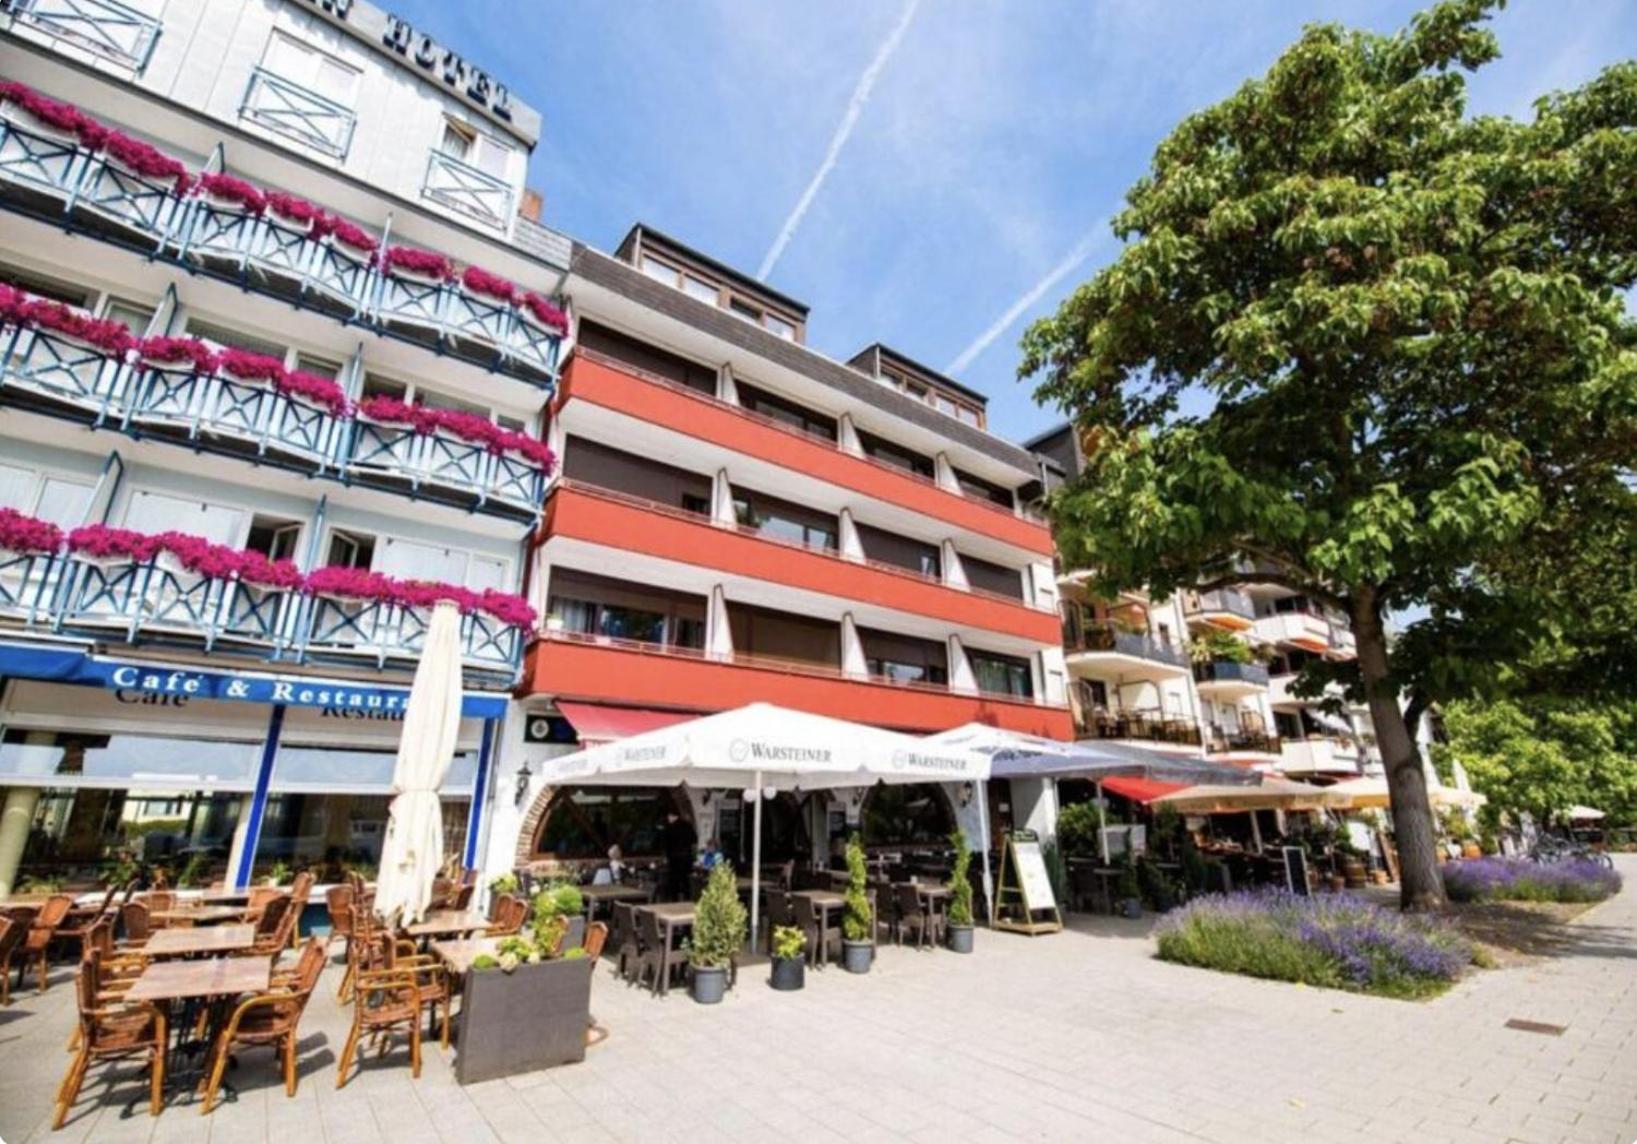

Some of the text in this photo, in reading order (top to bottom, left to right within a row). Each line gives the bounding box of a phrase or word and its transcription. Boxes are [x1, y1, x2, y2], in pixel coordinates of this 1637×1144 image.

[382, 14, 513, 122] HOTEL
[113, 666, 204, 693] Café
[226, 679, 250, 698] &
[321, 706, 405, 722] Restau
[751, 742, 832, 762] WARSTEINER
